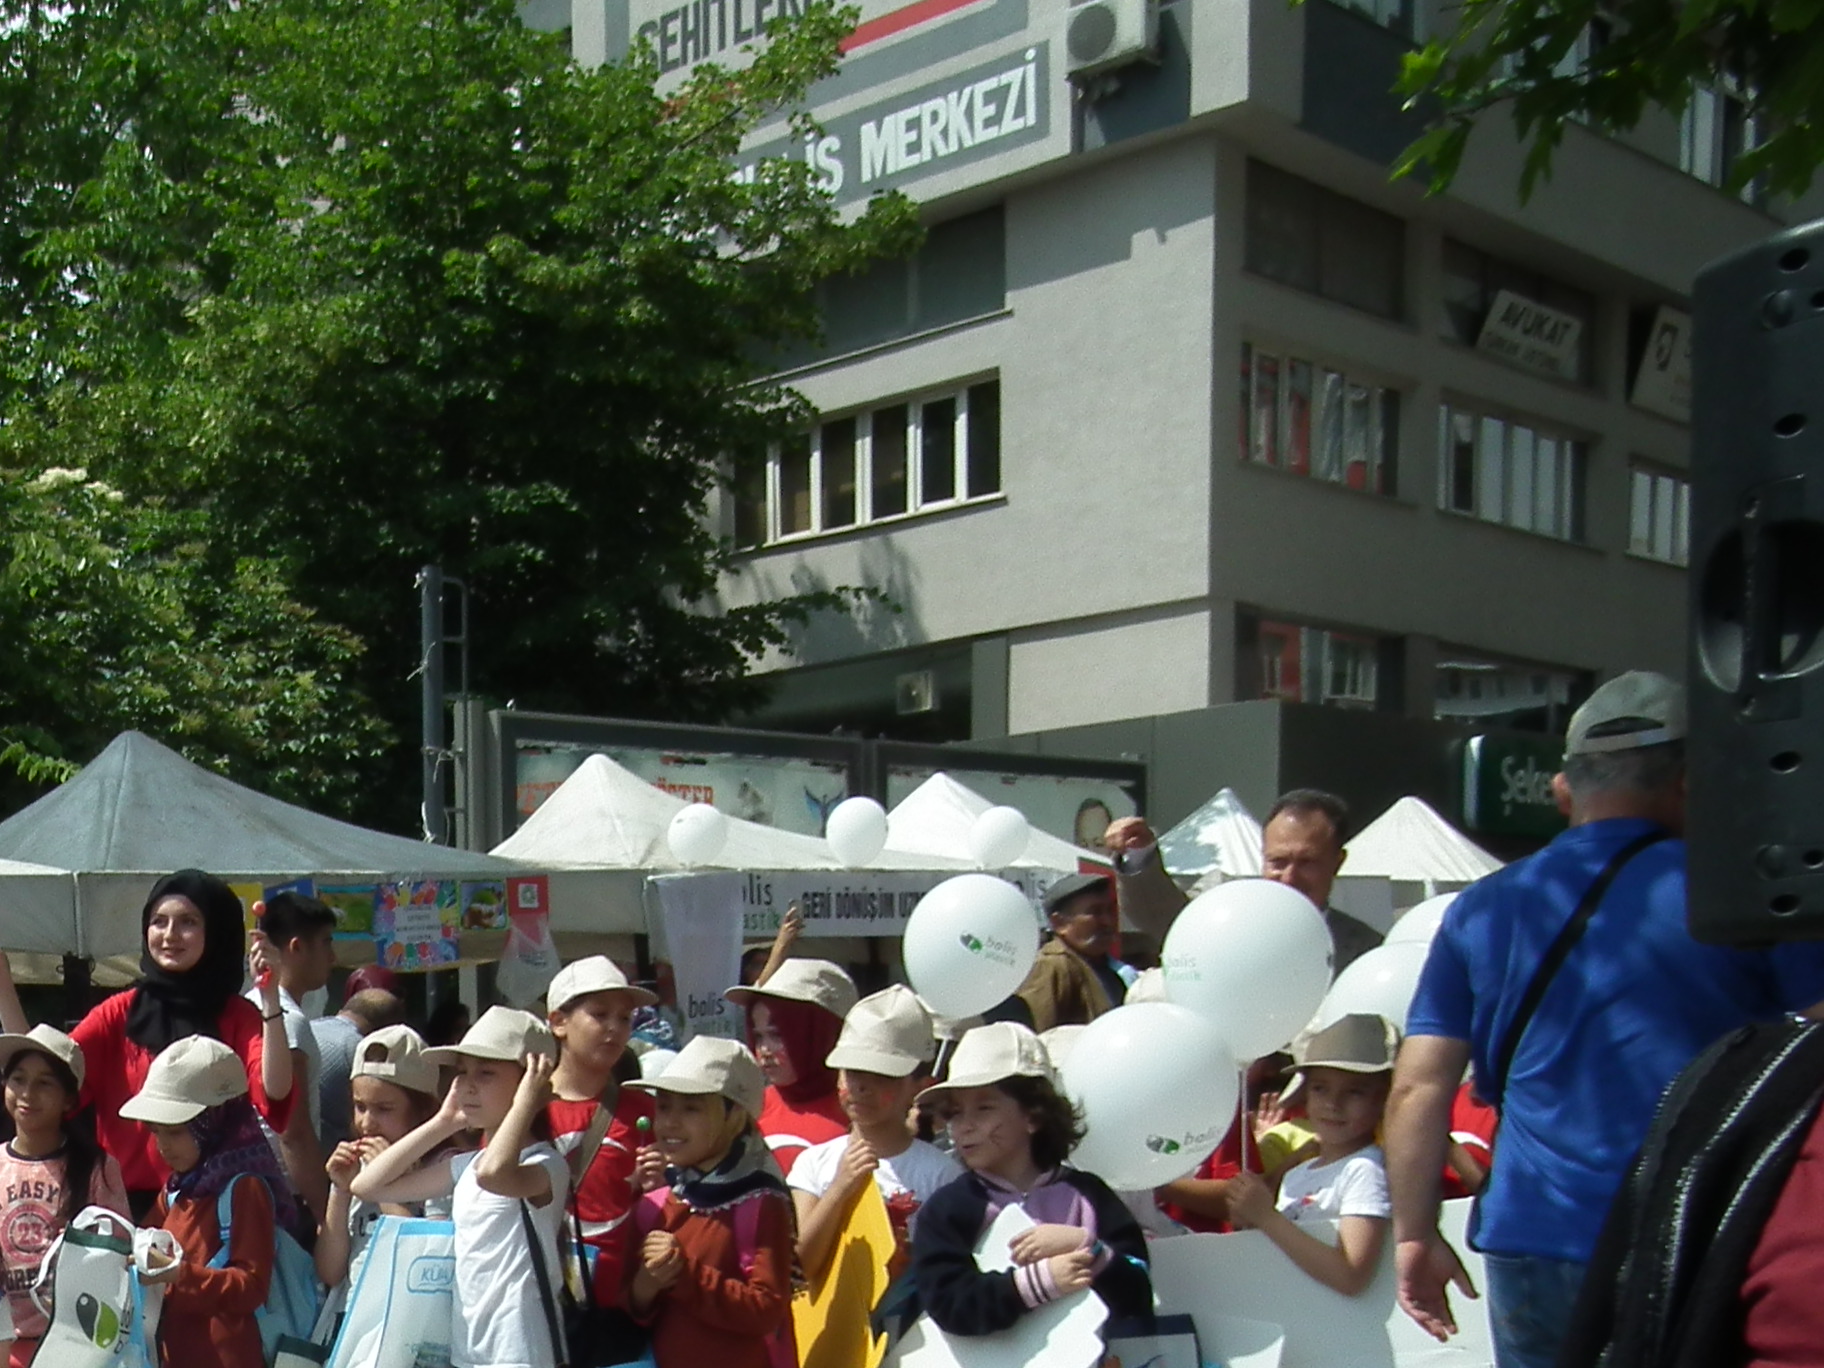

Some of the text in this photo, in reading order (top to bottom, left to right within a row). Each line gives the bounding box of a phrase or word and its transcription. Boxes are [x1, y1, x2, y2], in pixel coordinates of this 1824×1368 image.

[858, 48, 1039, 185] MERKEZİ
[1498, 301, 1572, 347] AVUKAT
[1500, 755, 1558, 817] Şeke
[801, 887, 832, 918] GERİ
[5, 1180, 61, 1204] EASY
